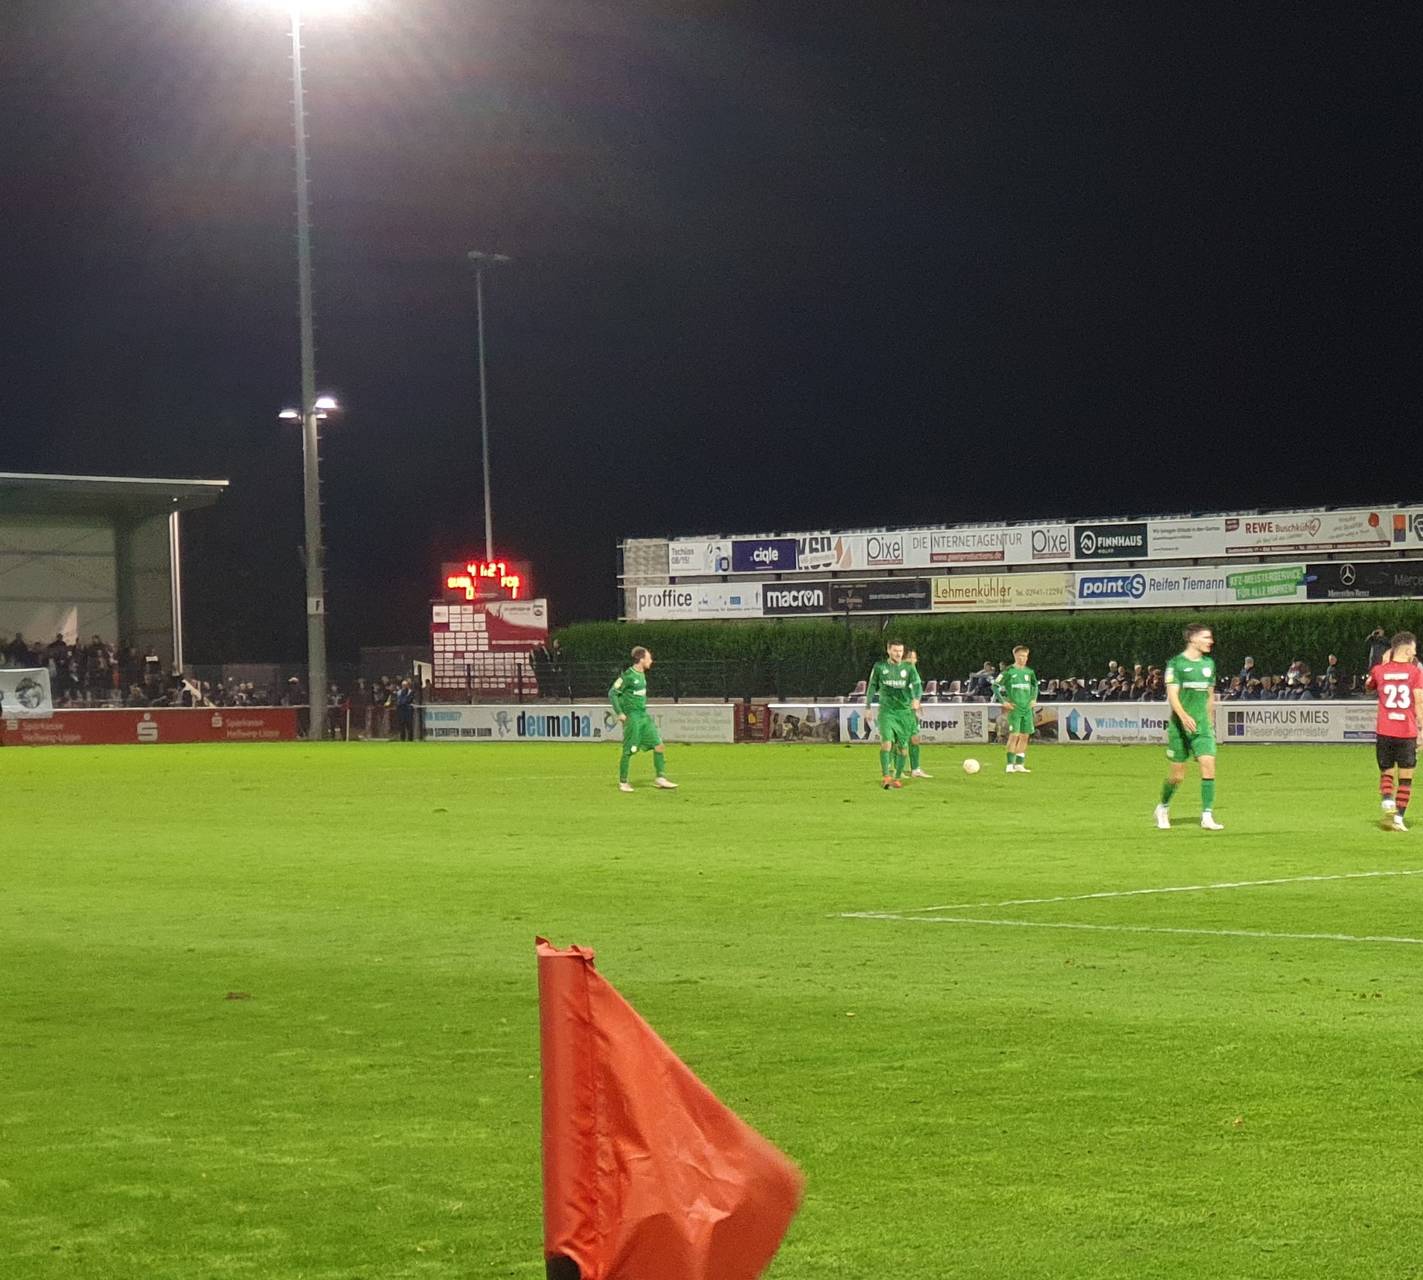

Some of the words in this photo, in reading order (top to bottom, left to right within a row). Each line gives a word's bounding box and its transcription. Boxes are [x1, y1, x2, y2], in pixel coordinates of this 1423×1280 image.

[1245, 522, 1273, 534] REWE
[912, 537, 928, 550] DIE
[1097, 536, 1142, 548] FINNHAUS
[936, 578, 1012, 598] Lehmenkühler
[1083, 577, 1124, 597] point
[1131, 576, 1144, 596] S
[1150, 577, 1180, 592] Reifen
[1182, 574, 1224, 590] Tiemann
[638, 589, 692, 611] proffice
[767, 589, 823, 608] macron
[1383, 684, 1411, 709] 23
[1094, 717, 1138, 729] Wilhelm
[1246, 710, 1297, 724] MARKUS
[1300, 710, 1329, 724] MIES
[1246, 725, 1329, 739] Fliesenlegermeister
